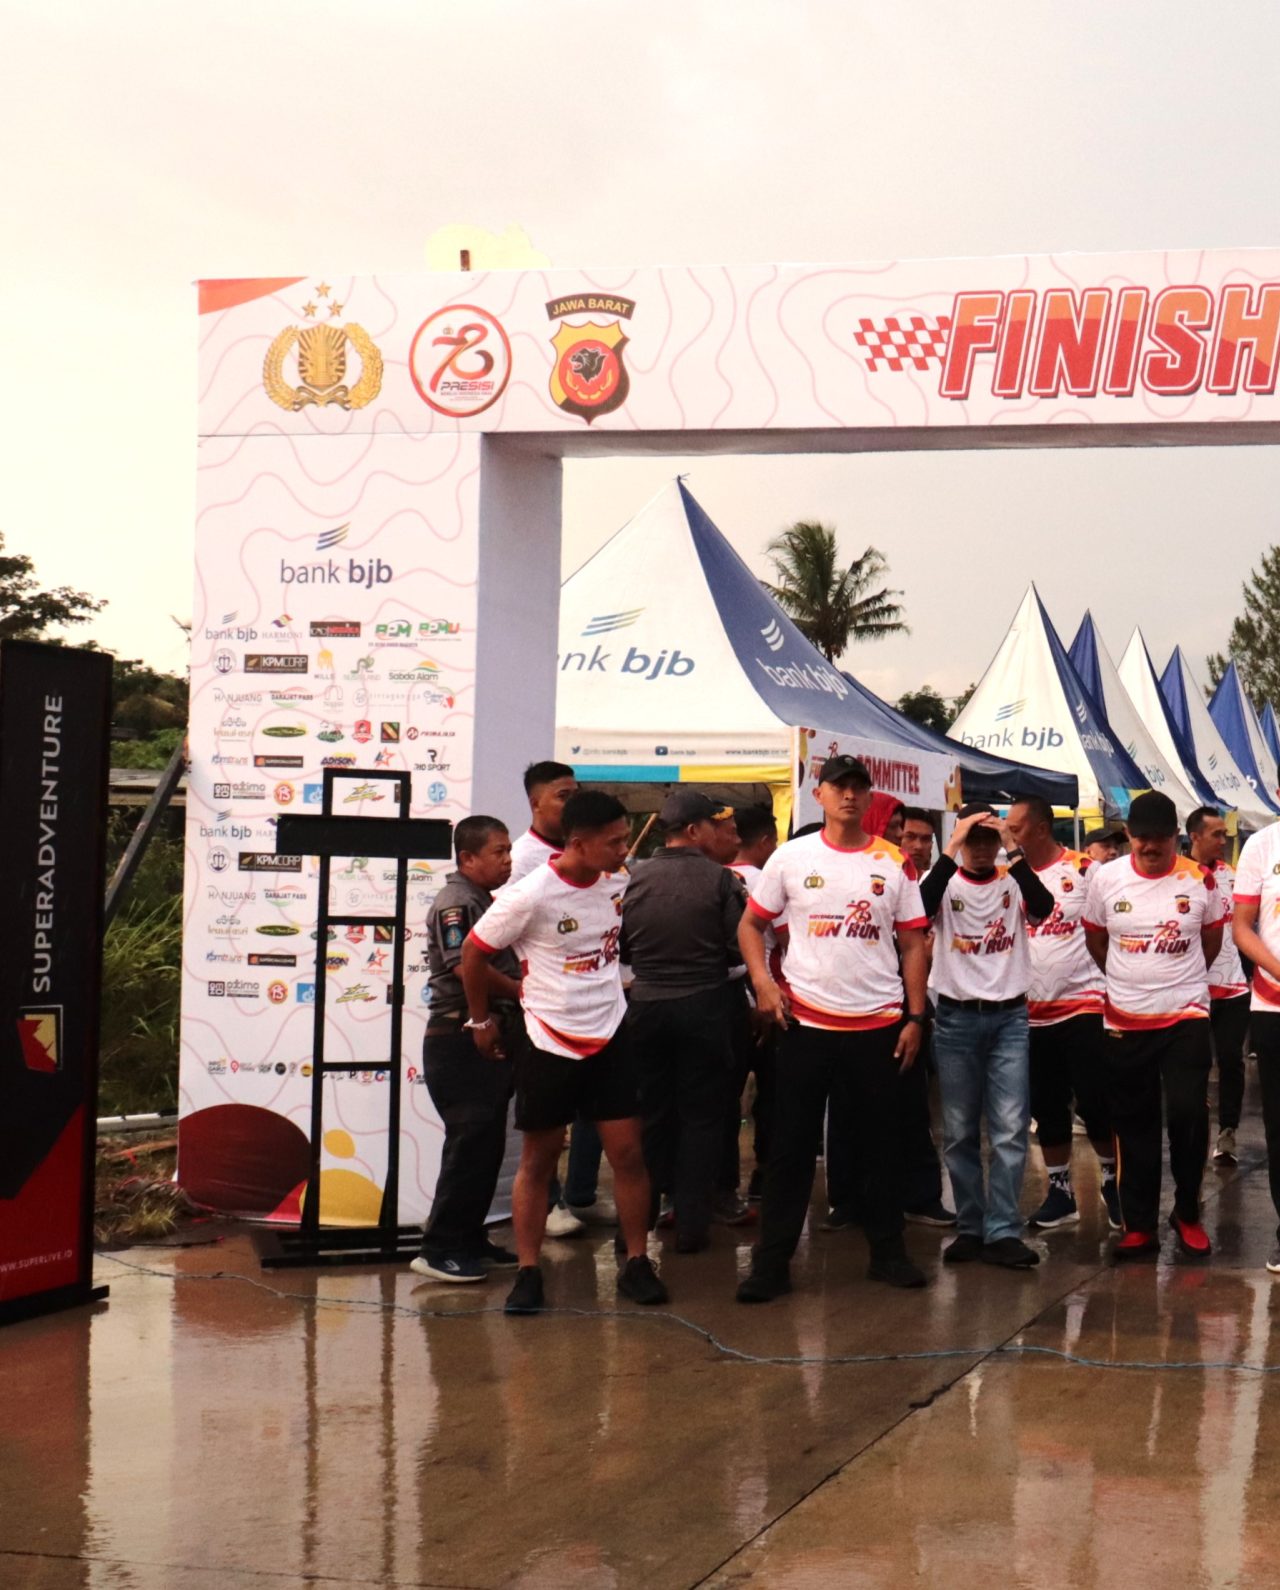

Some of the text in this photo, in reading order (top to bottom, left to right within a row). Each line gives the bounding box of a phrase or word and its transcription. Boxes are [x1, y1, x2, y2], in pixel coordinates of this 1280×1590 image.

[552, 298, 630, 315] JAWA BARAT
[440, 380, 495, 391] PRESISI
[279, 558, 393, 589] bank bjb
[205, 627, 258, 642] bank bjb
[557, 645, 696, 681] nk bjb
[389, 672, 439, 681] Sabda Alam
[755, 657, 850, 701] bank bjb
[960, 727, 1065, 751] bank bjb
[200, 826, 229, 838] bank
[231, 825, 252, 840] bjb
[32, 693, 63, 993] SUPERADVENTURE
[256, 855, 301, 866] KPMCORP
[411, 874, 433, 882] Alam
[807, 921, 880, 940] FUN RUN
[1041, 920, 1078, 936] RUN
[985, 933, 1015, 954] RUN
[1155, 938, 1191, 954] RUN
